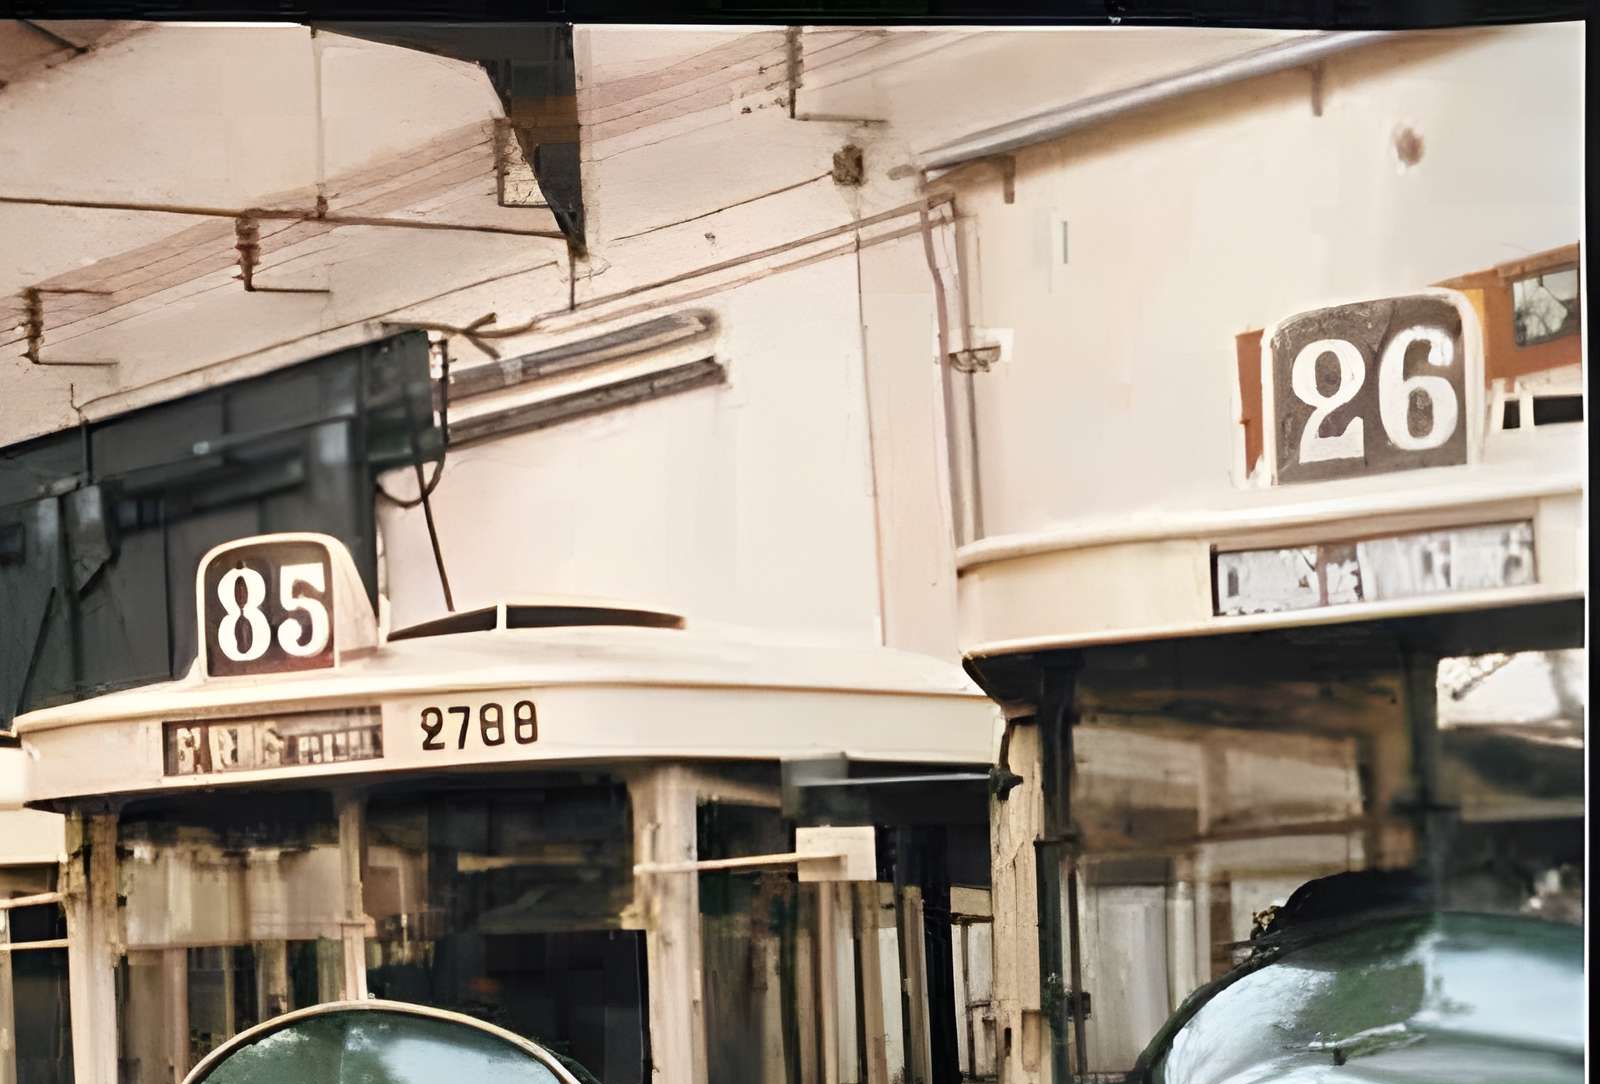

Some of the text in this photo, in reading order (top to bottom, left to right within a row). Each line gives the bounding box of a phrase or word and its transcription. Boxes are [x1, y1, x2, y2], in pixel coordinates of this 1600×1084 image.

[1291, 325, 1458, 464] 26
[216, 567, 330, 662] 85
[420, 700, 538, 750] 2788
